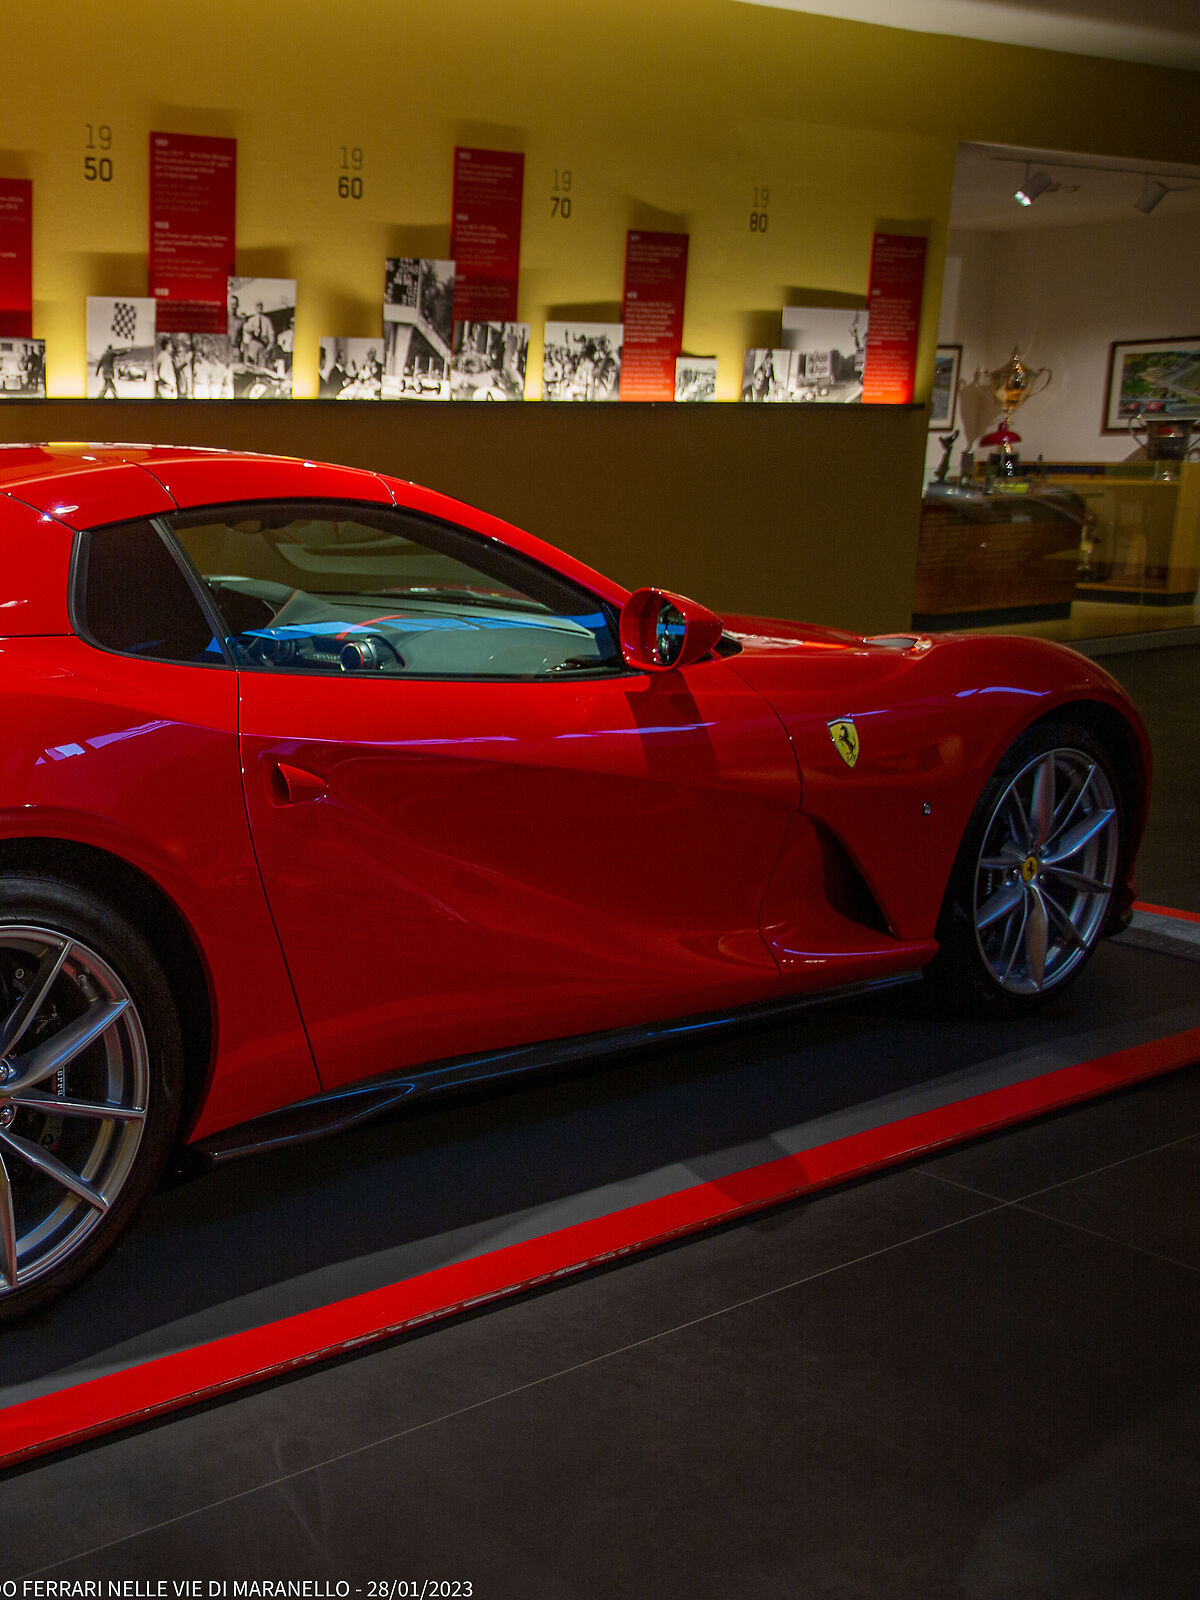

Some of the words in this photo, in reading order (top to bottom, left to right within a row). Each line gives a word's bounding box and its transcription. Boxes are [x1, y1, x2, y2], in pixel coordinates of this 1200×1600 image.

[86, 125, 112, 151] 19
[85, 156, 113, 182] 50
[341, 147, 363, 171] 19
[339, 175, 363, 199] 60
[552, 170, 572, 193] 19
[550, 196, 572, 219] 70
[749, 212, 768, 233] 80
